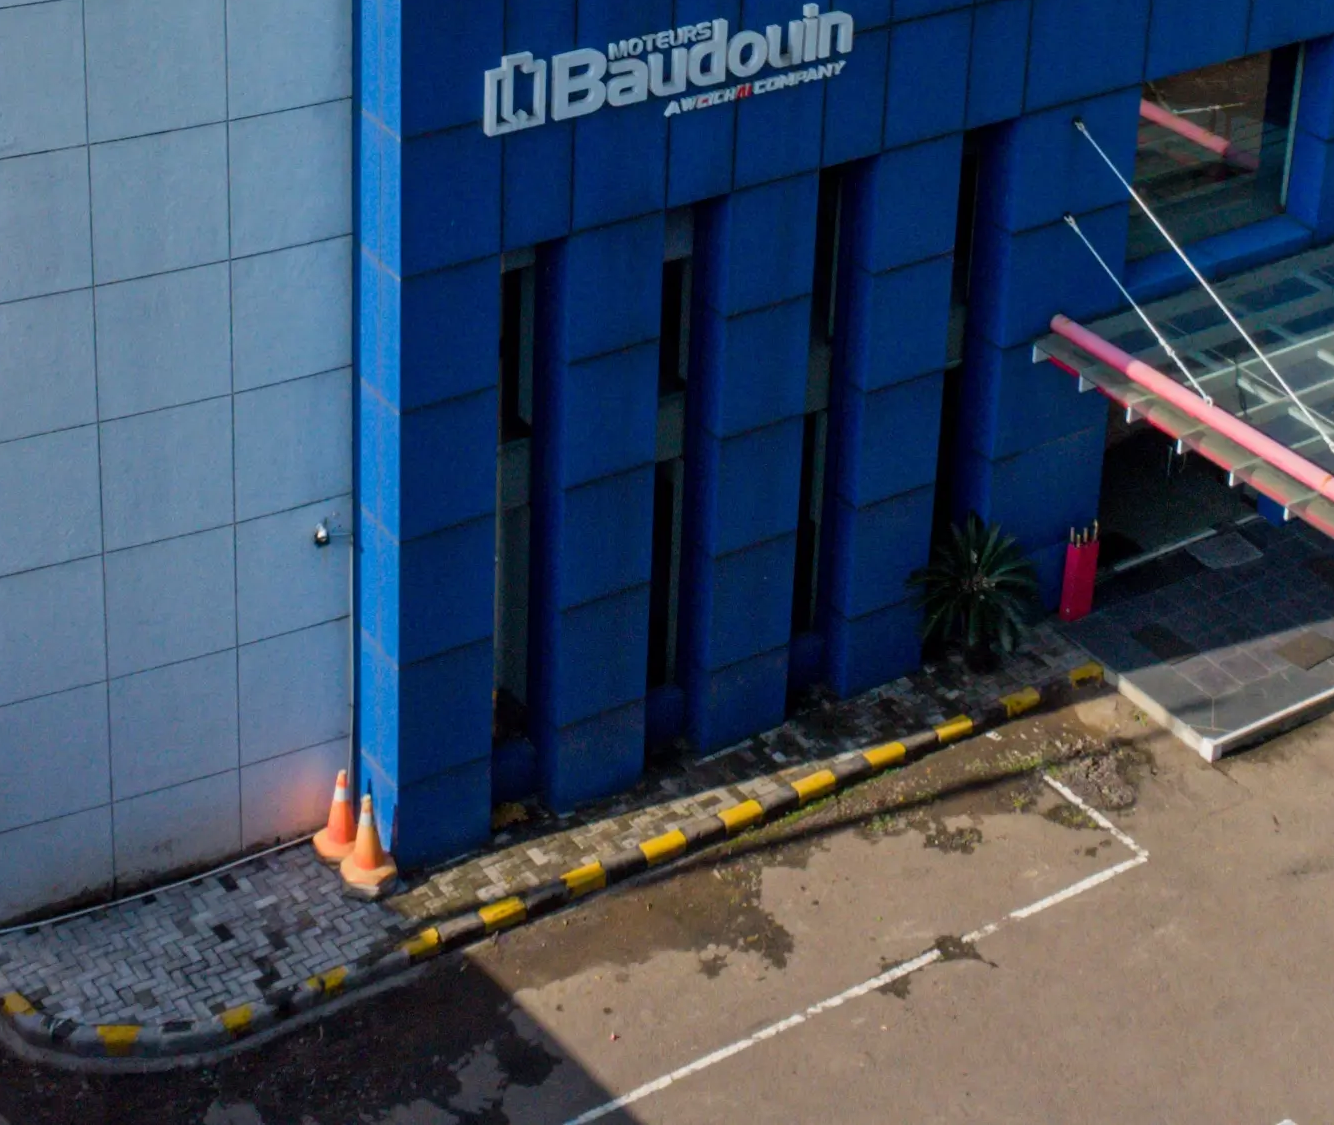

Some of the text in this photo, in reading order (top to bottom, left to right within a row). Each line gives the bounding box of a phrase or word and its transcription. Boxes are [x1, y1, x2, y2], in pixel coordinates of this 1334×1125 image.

[607, 21, 712, 61] MOTEURS
[551, 3, 855, 121] Baudouin
[753, 60, 847, 95] COMPANY
